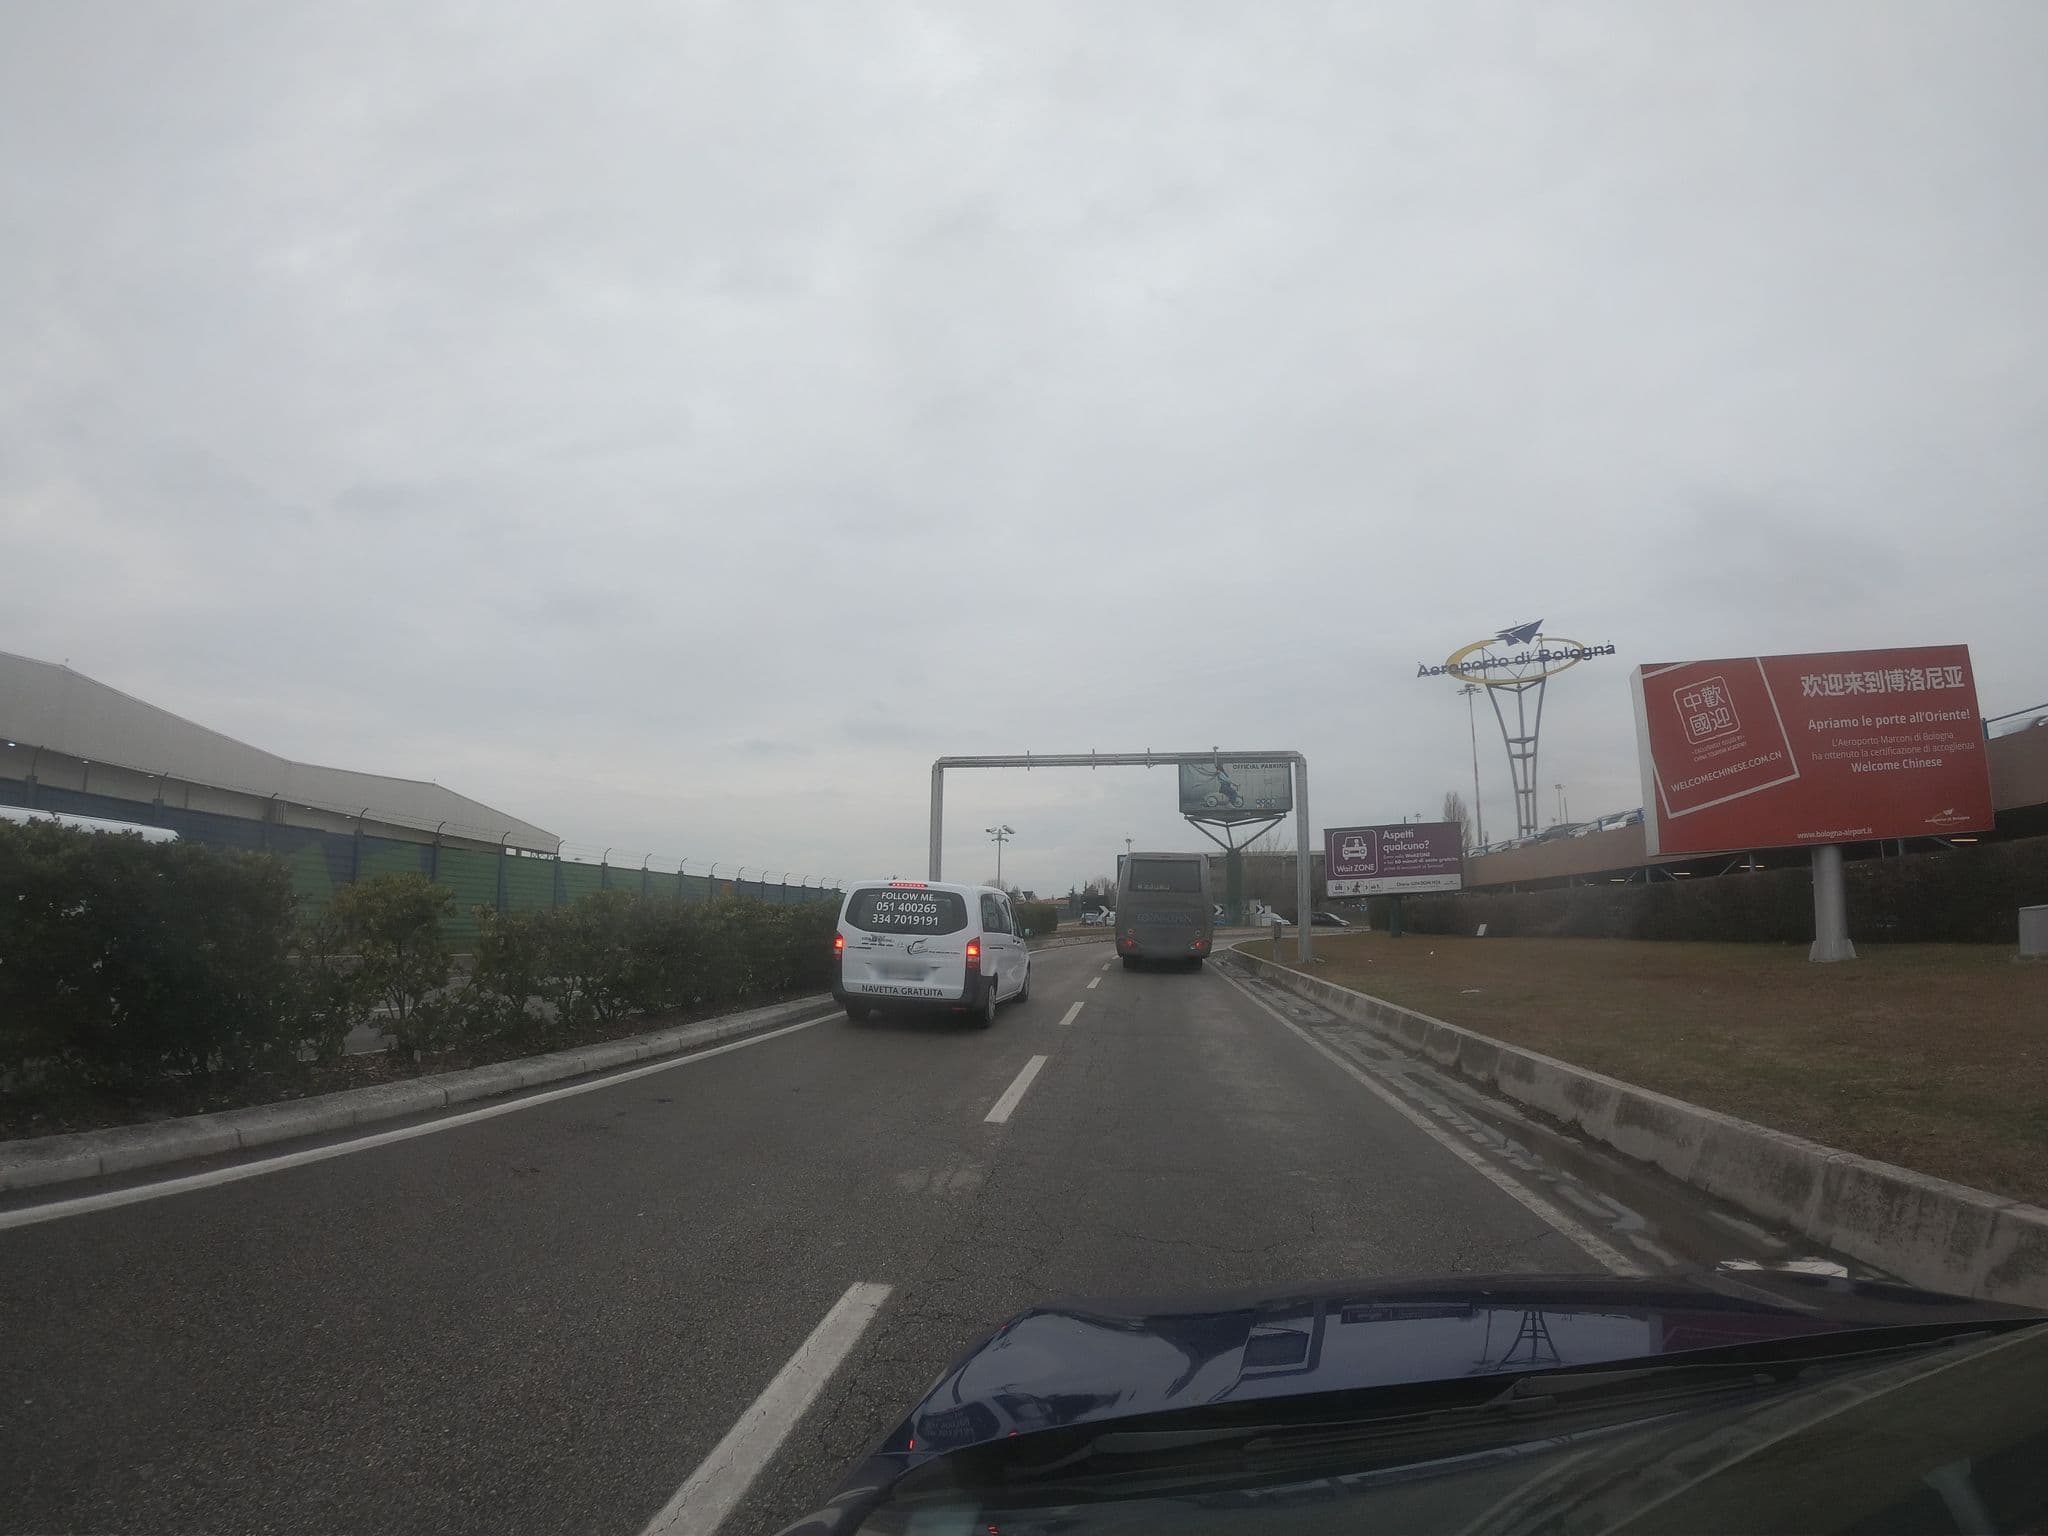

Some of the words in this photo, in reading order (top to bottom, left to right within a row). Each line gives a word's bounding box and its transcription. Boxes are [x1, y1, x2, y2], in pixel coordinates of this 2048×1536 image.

[1417, 655, 1509, 678] Aeroporto
[1514, 651, 1531, 665] di
[1537, 642, 1616, 663] Bologna
[1800, 665, 1965, 698] 欢迎来到博洛尼亚
[1808, 716, 1859, 733] Apriamo
[1862, 715, 1873, 728] le
[1876, 713, 1907, 729] porte
[1881, 733, 1913, 744] Marconi
[1914, 732, 1922, 742] di
[1923, 731, 1954, 743] Bologna
[1812, 751, 1823, 761] ha
[1824, 749, 1859, 760] ottenuto
[1861, 748, 1869, 758] la
[1870, 745, 1922, 757] certificazione
[1923, 743, 1931, 754] di
[1932, 741, 1976, 754] accoglienza
[1671, 750, 1782, 792] WELCOMECHINESE.COM.CN
[1851, 760, 1900, 773] Welcome
[1902, 756, 1943, 769] Chinese
[1382, 828, 1414, 841] Aspetti
[1797, 826, 1873, 840] www.bologna-airport.it
[1383, 840, 1430, 854] qualcuno?
[881, 891, 919, 901] FOLLOW
[920, 893, 934, 901] ME
[876, 901, 895, 911] 051
[898, 902, 937, 914] 400265
[871, 914, 891, 924] 334
[894, 914, 939, 926] 7019191
[861, 984, 899, 994] NAVETTA
[901, 986, 943, 997] GRATUITA
